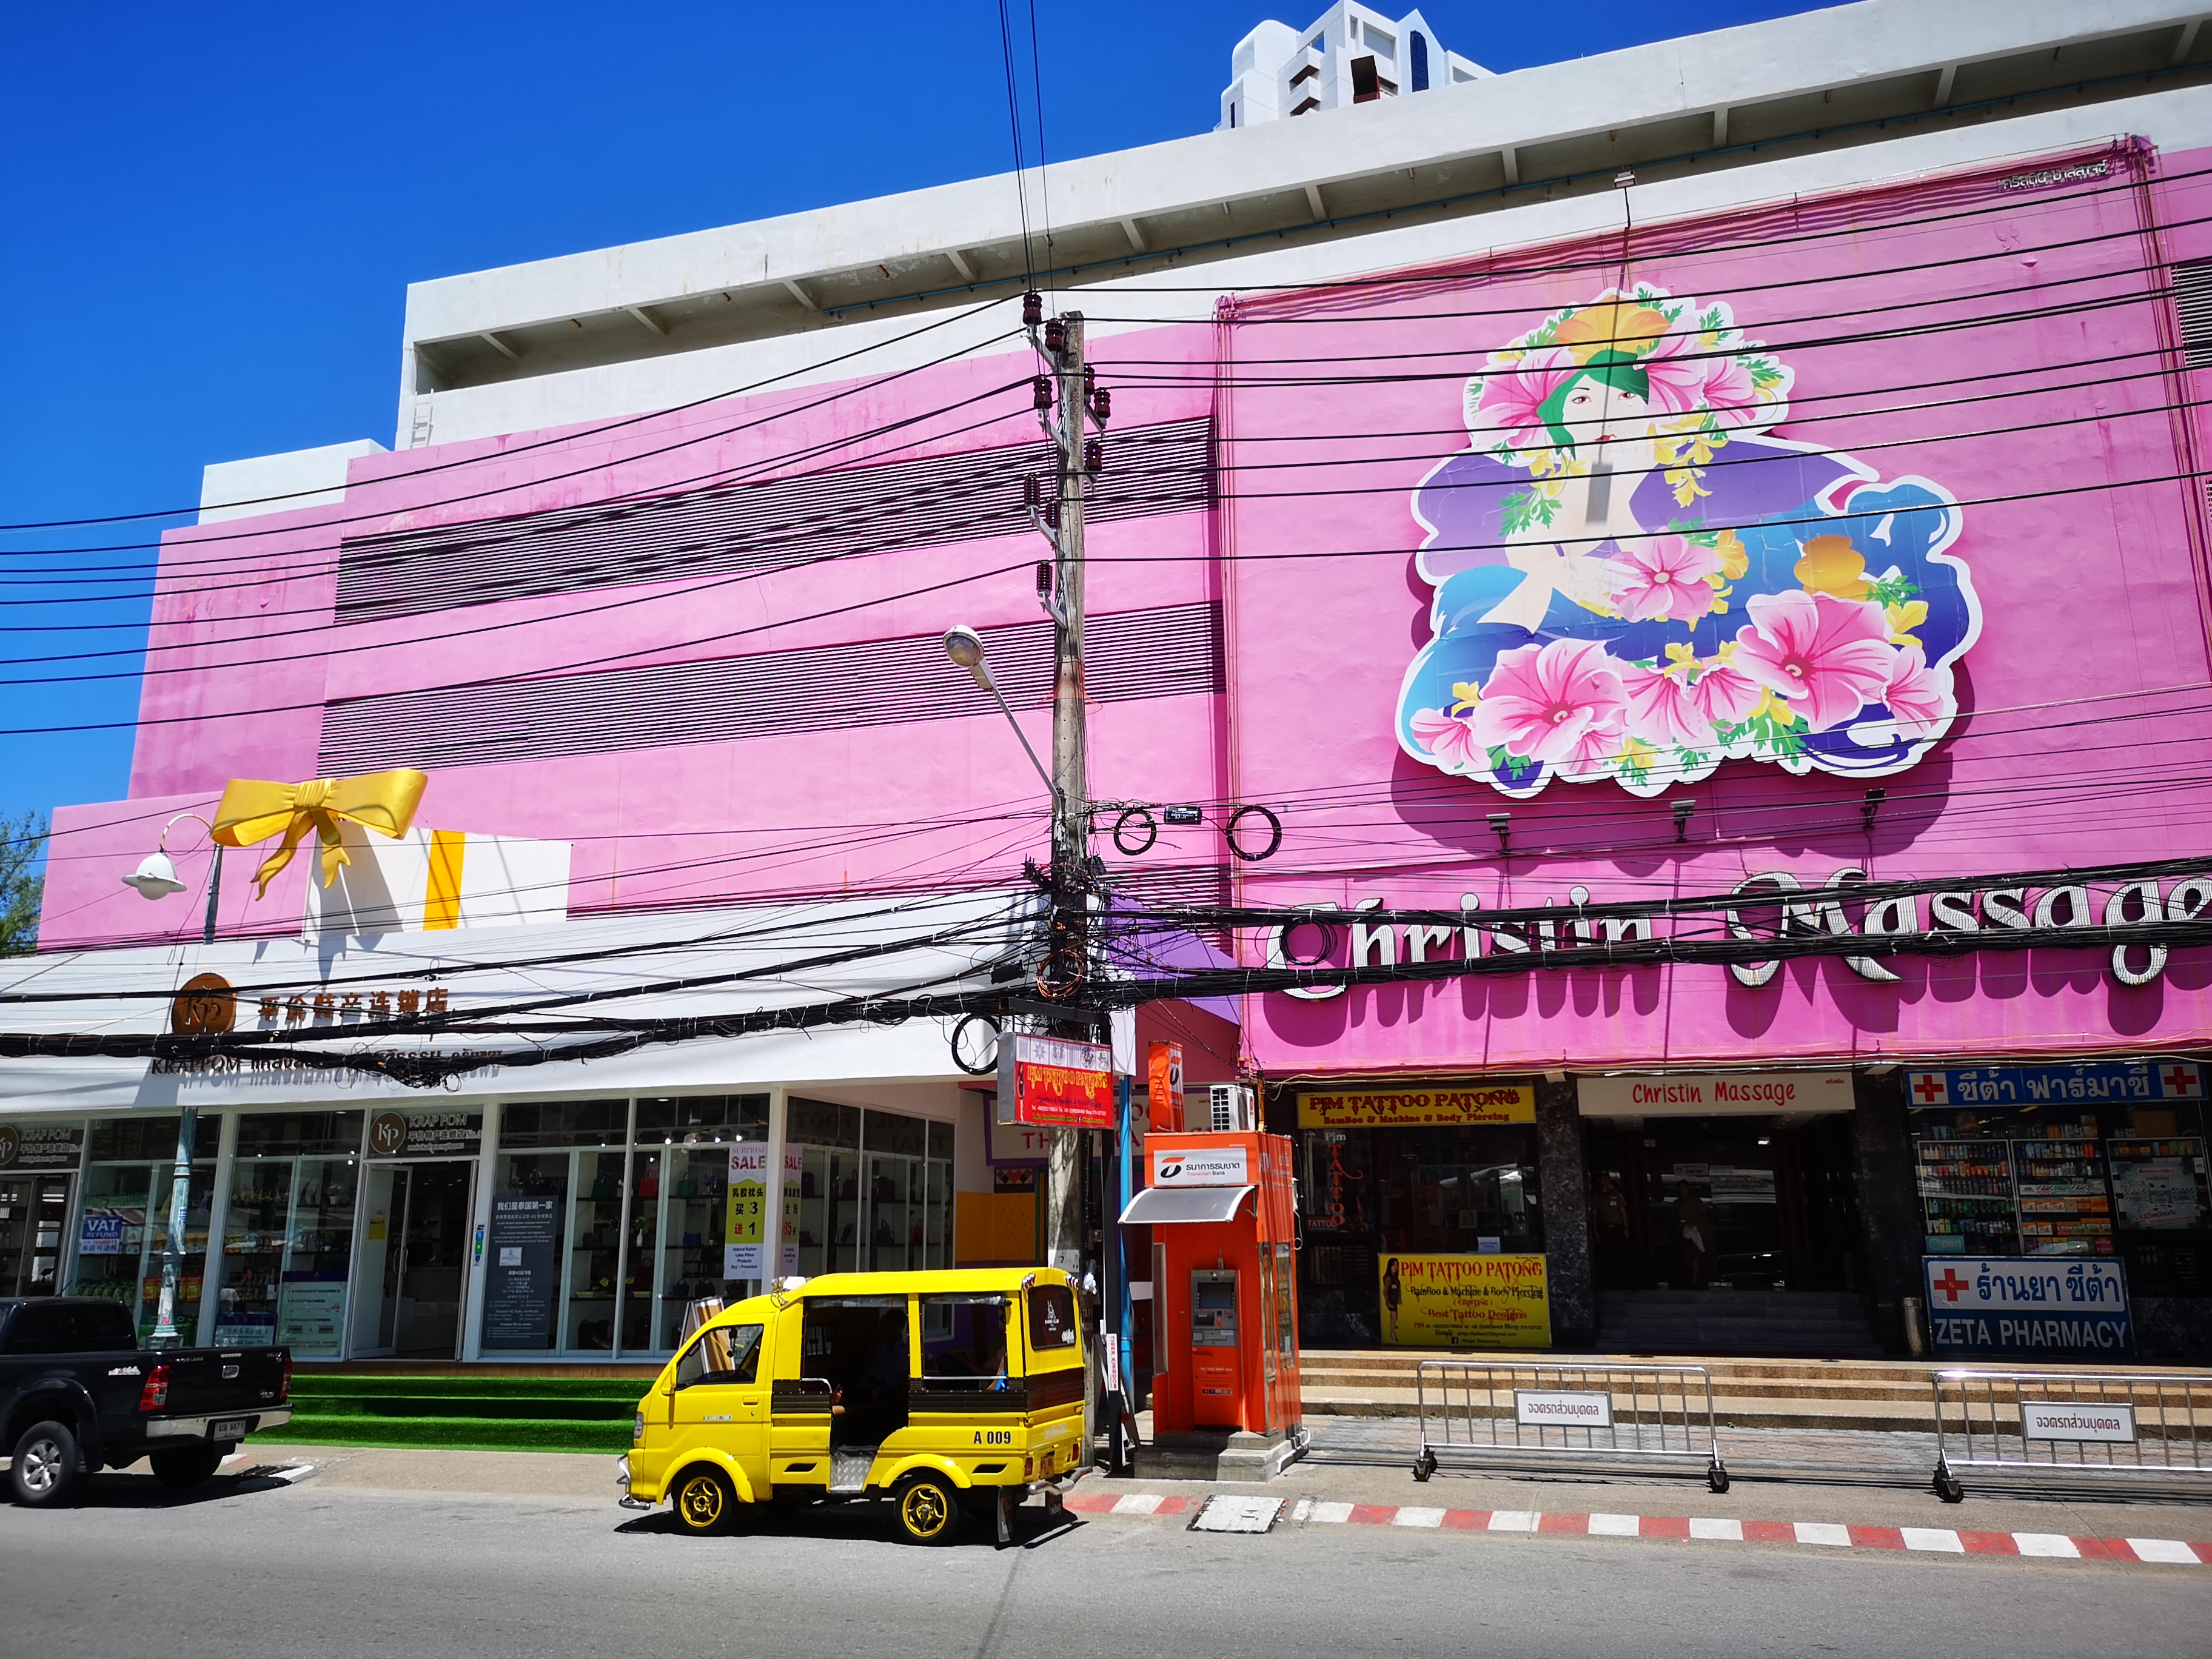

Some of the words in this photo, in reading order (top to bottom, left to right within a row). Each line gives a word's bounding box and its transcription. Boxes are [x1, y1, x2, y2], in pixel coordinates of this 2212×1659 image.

[1957, 1070, 2016, 1102] ซีต้า
[2026, 1065, 2150, 1099] ฟาร์มาซี
[1632, 1083, 1702, 1104] Christin
[1715, 1081, 1795, 1106] Massage
[1348, 1094, 1431, 1115] TATTOO
[1435, 1089, 1520, 1113] PATONG
[409, 1115, 439, 1128] KRAP
[440, 1114, 468, 1127] POM
[1379, 1114, 1420, 1123] Machine
[1436, 1114, 1462, 1122] Body
[1467, 1113, 1509, 1122] Piercing
[731, 1155, 766, 1170] SALE
[785, 1155, 802, 1170] SALE
[732, 1187, 763, 1198] 乳胶枕头
[497, 1201, 553, 1211] 我们是泰国第一家
[736, 1203, 744, 1215] 买
[749, 1201, 758, 1215] 3
[87, 1219, 119, 1232] VAT
[734, 1223, 743, 1235] 送
[749, 1222, 756, 1235] 1
[1427, 1261, 1483, 1284] TATTOO
[1486, 1259, 1543, 1284] PATONG
[1976, 1262, 2060, 1302] ร้านยา
[2066, 1264, 2120, 1303] ซีต้า
[1934, 1318, 1992, 1345] ZETA
[1999, 1318, 2127, 1348] PHARMACY
[1527, 1399, 1599, 1418] จอดรถส่วนบุคคล
[2036, 1412, 2120, 1433] จอดรถส่วนบุคคล
[973, 1431, 982, 1444] A
[987, 1431, 1011, 1444] 009
